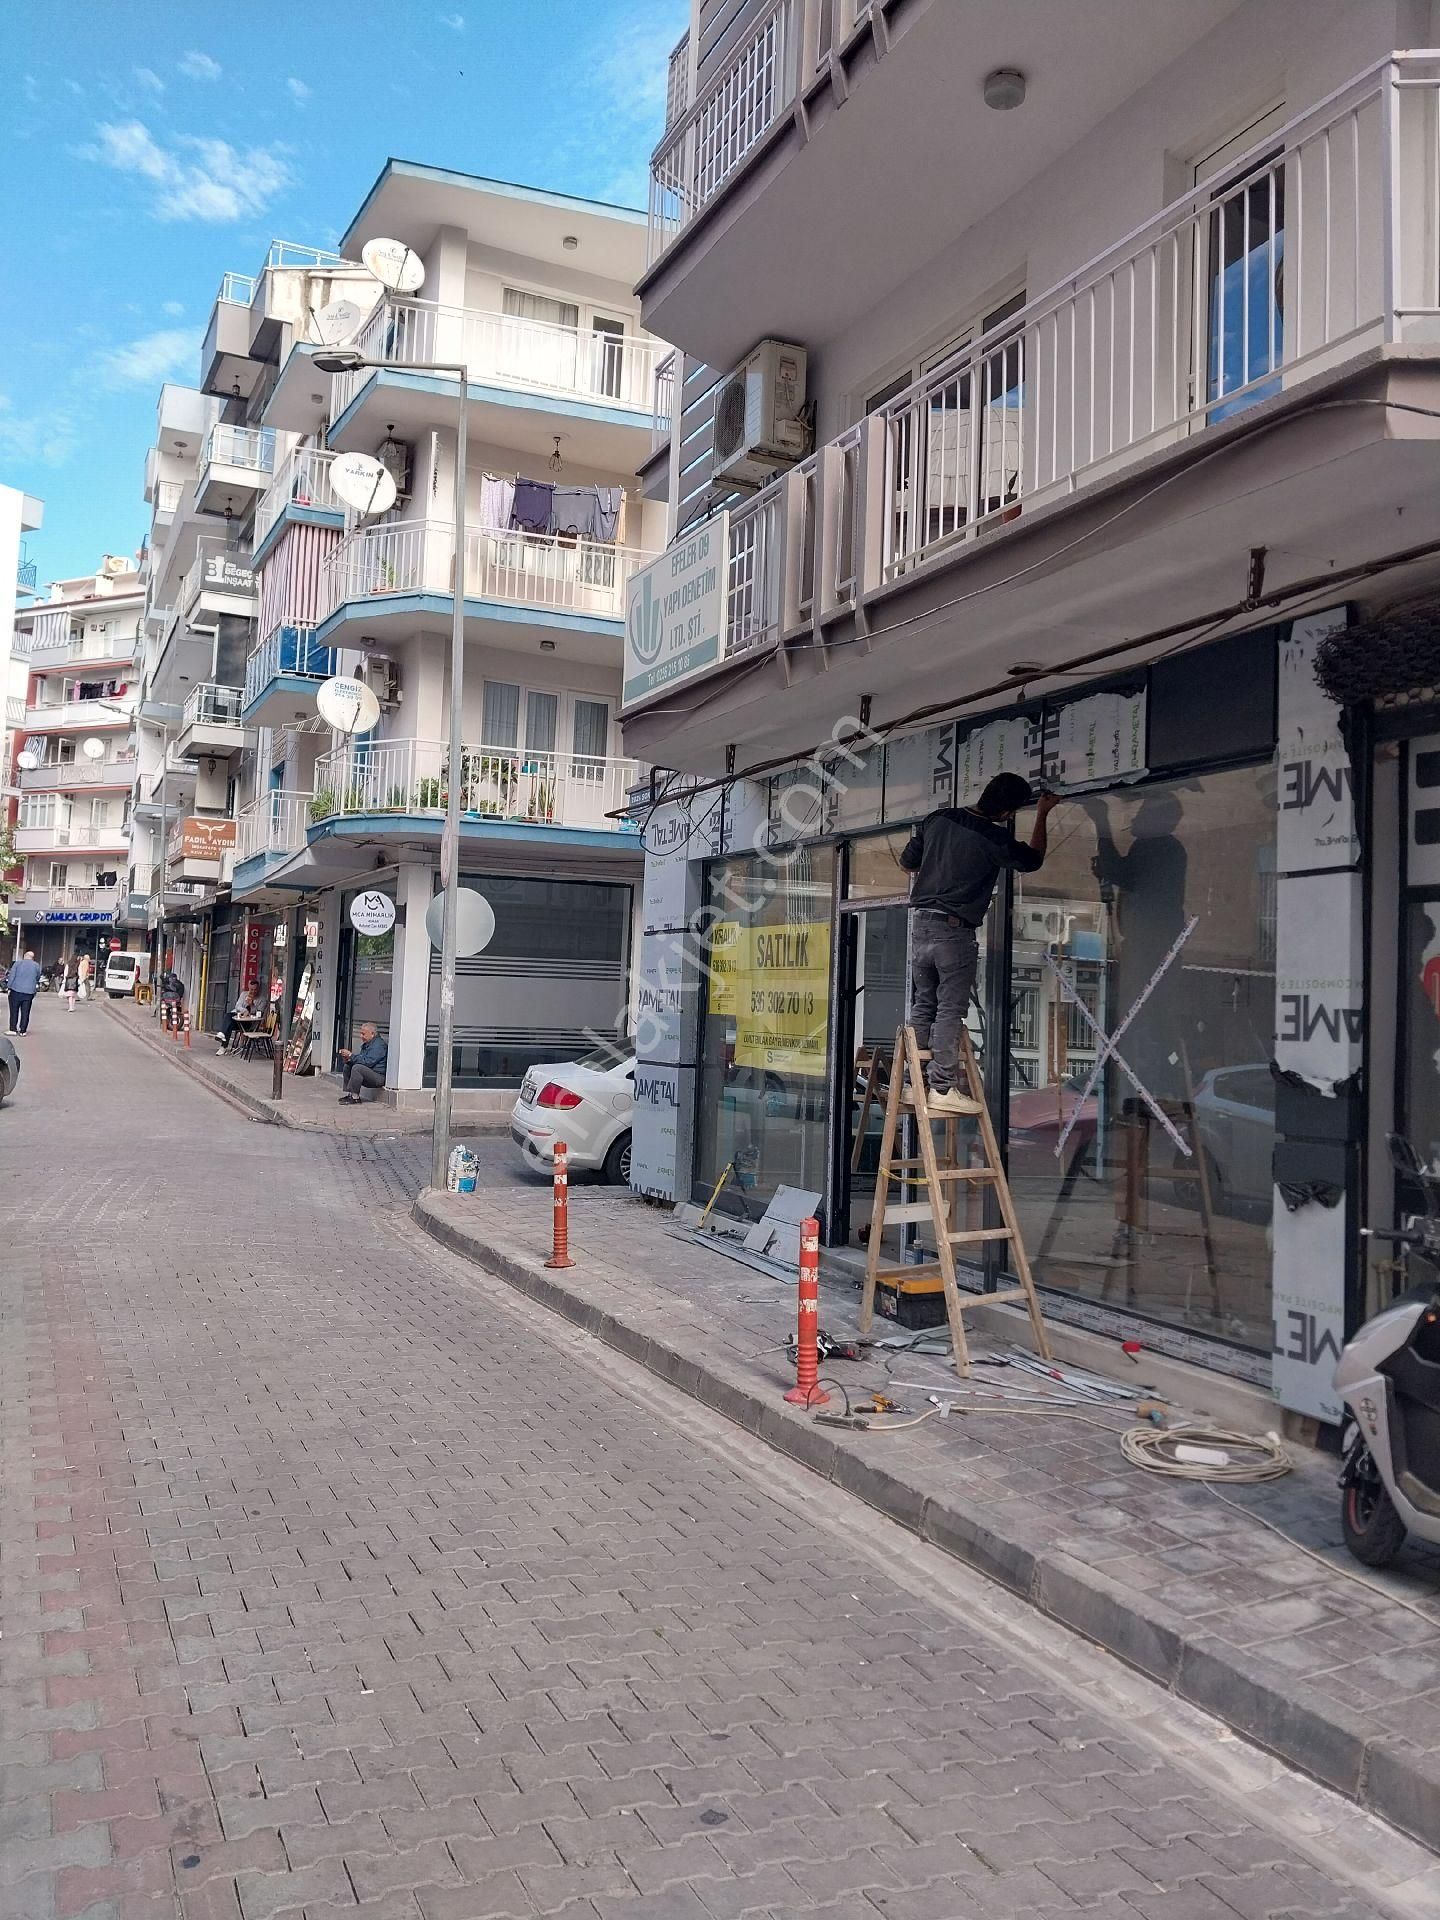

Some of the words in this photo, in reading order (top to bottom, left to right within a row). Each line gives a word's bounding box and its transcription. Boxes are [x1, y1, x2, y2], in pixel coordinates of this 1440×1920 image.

[345, 468, 374, 478] YARKIN
[671, 544, 697, 578] EFELER
[663, 587, 681, 618] YAPI
[682, 566, 716, 606] DENETİM
[669, 622, 686, 651] LTD.
[184, 835, 207, 844] FADIL
[211, 838, 235, 847] AYDIN
[757, 932, 809, 968] SATILIK
[768, 991, 785, 1014] 302
[787, 991, 800, 1014] 70
